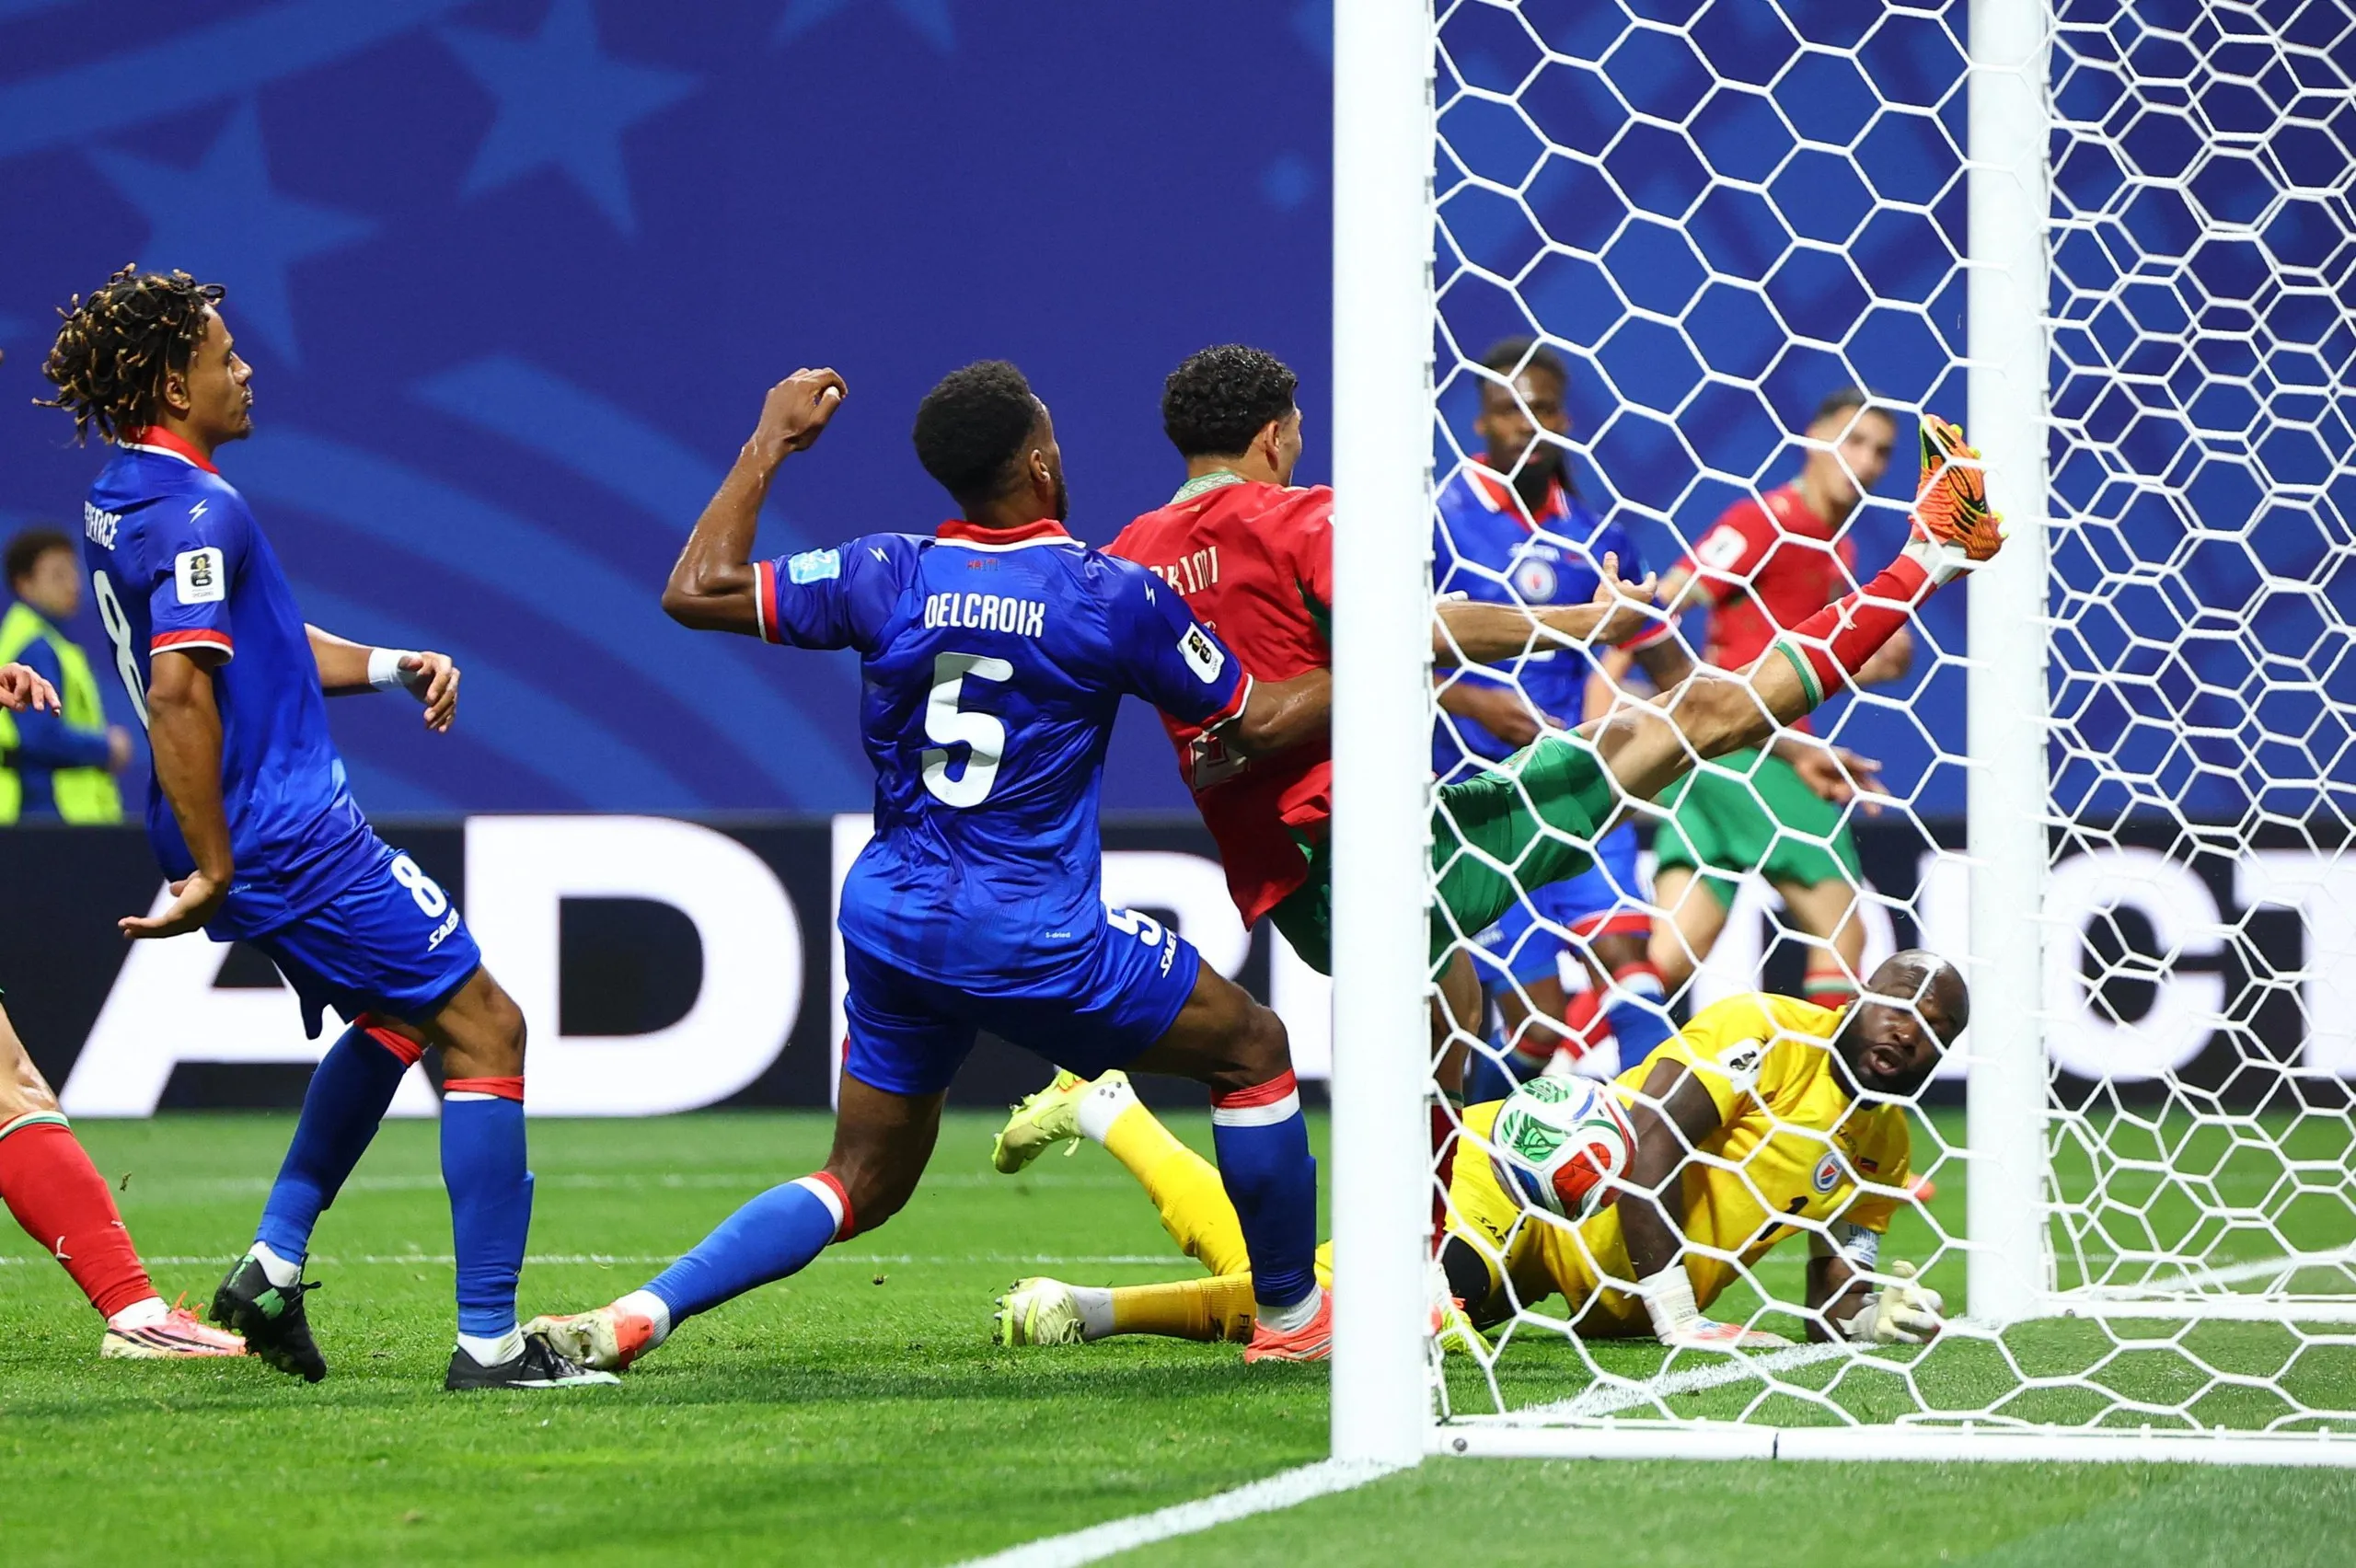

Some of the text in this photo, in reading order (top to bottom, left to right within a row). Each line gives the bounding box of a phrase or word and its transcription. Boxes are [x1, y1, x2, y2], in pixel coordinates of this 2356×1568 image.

[1149, 546, 1218, 597] KIMI
[924, 592, 1045, 639] DELCROIX
[921, 651, 1014, 809] 5
[390, 854, 448, 918] 8
[1106, 899, 1162, 947] 5
[57, 814, 874, 1117] AD
